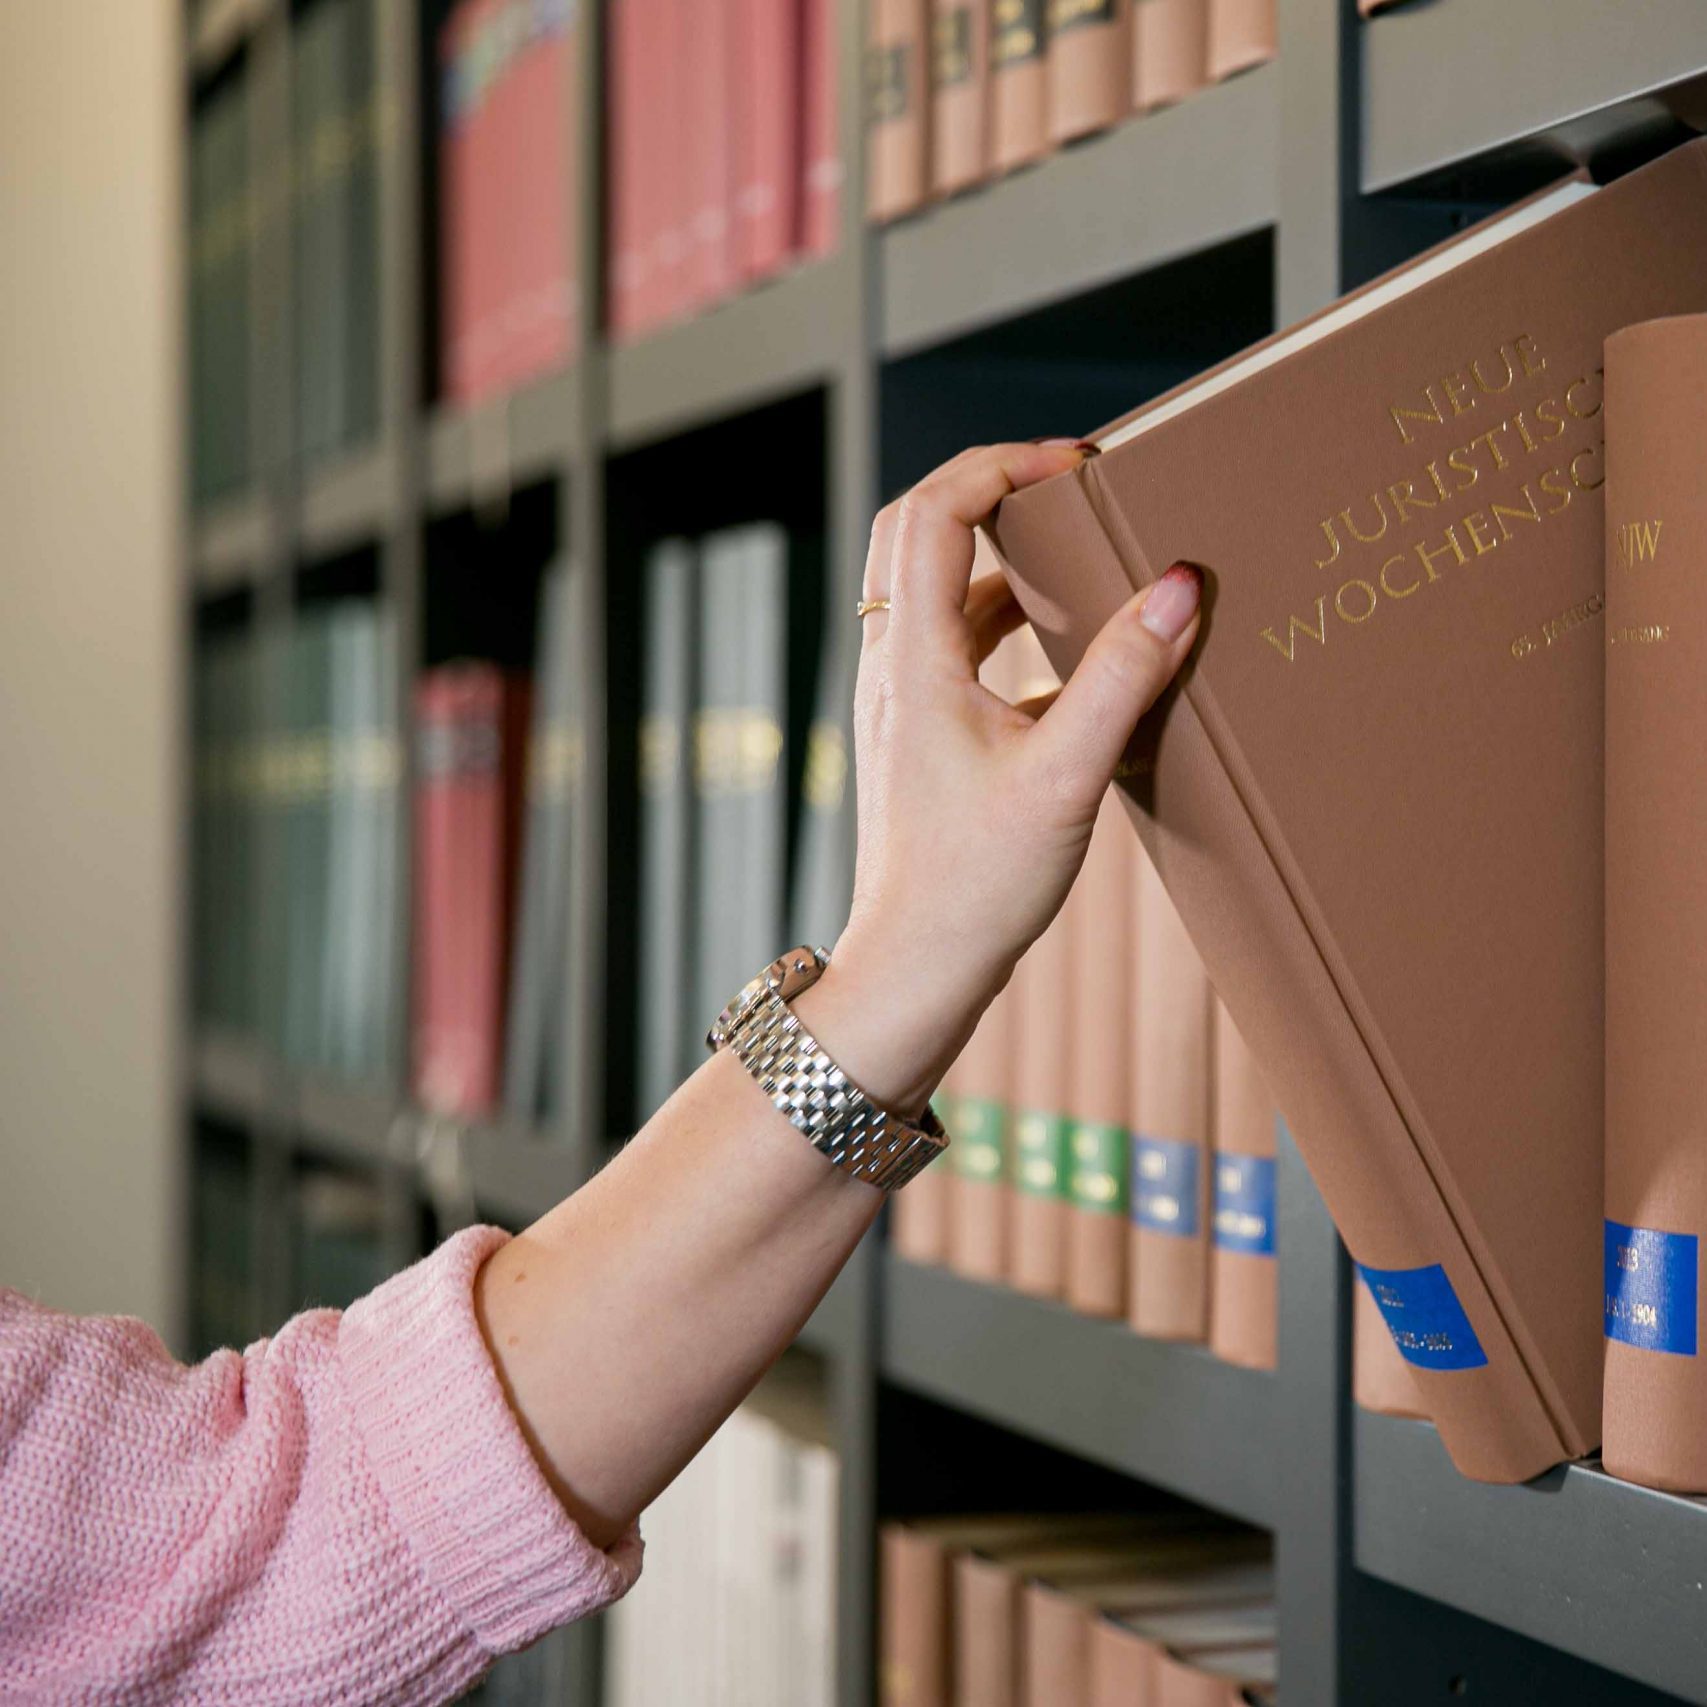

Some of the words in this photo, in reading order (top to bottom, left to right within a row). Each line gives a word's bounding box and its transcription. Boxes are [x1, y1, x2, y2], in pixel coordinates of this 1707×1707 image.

[1389, 333, 1547, 445] NEUE
[1314, 367, 1604, 570] JURISTISC
[1260, 442, 1605, 662] WOCHENSC
[1542, 592, 1604, 644] JAHRG
